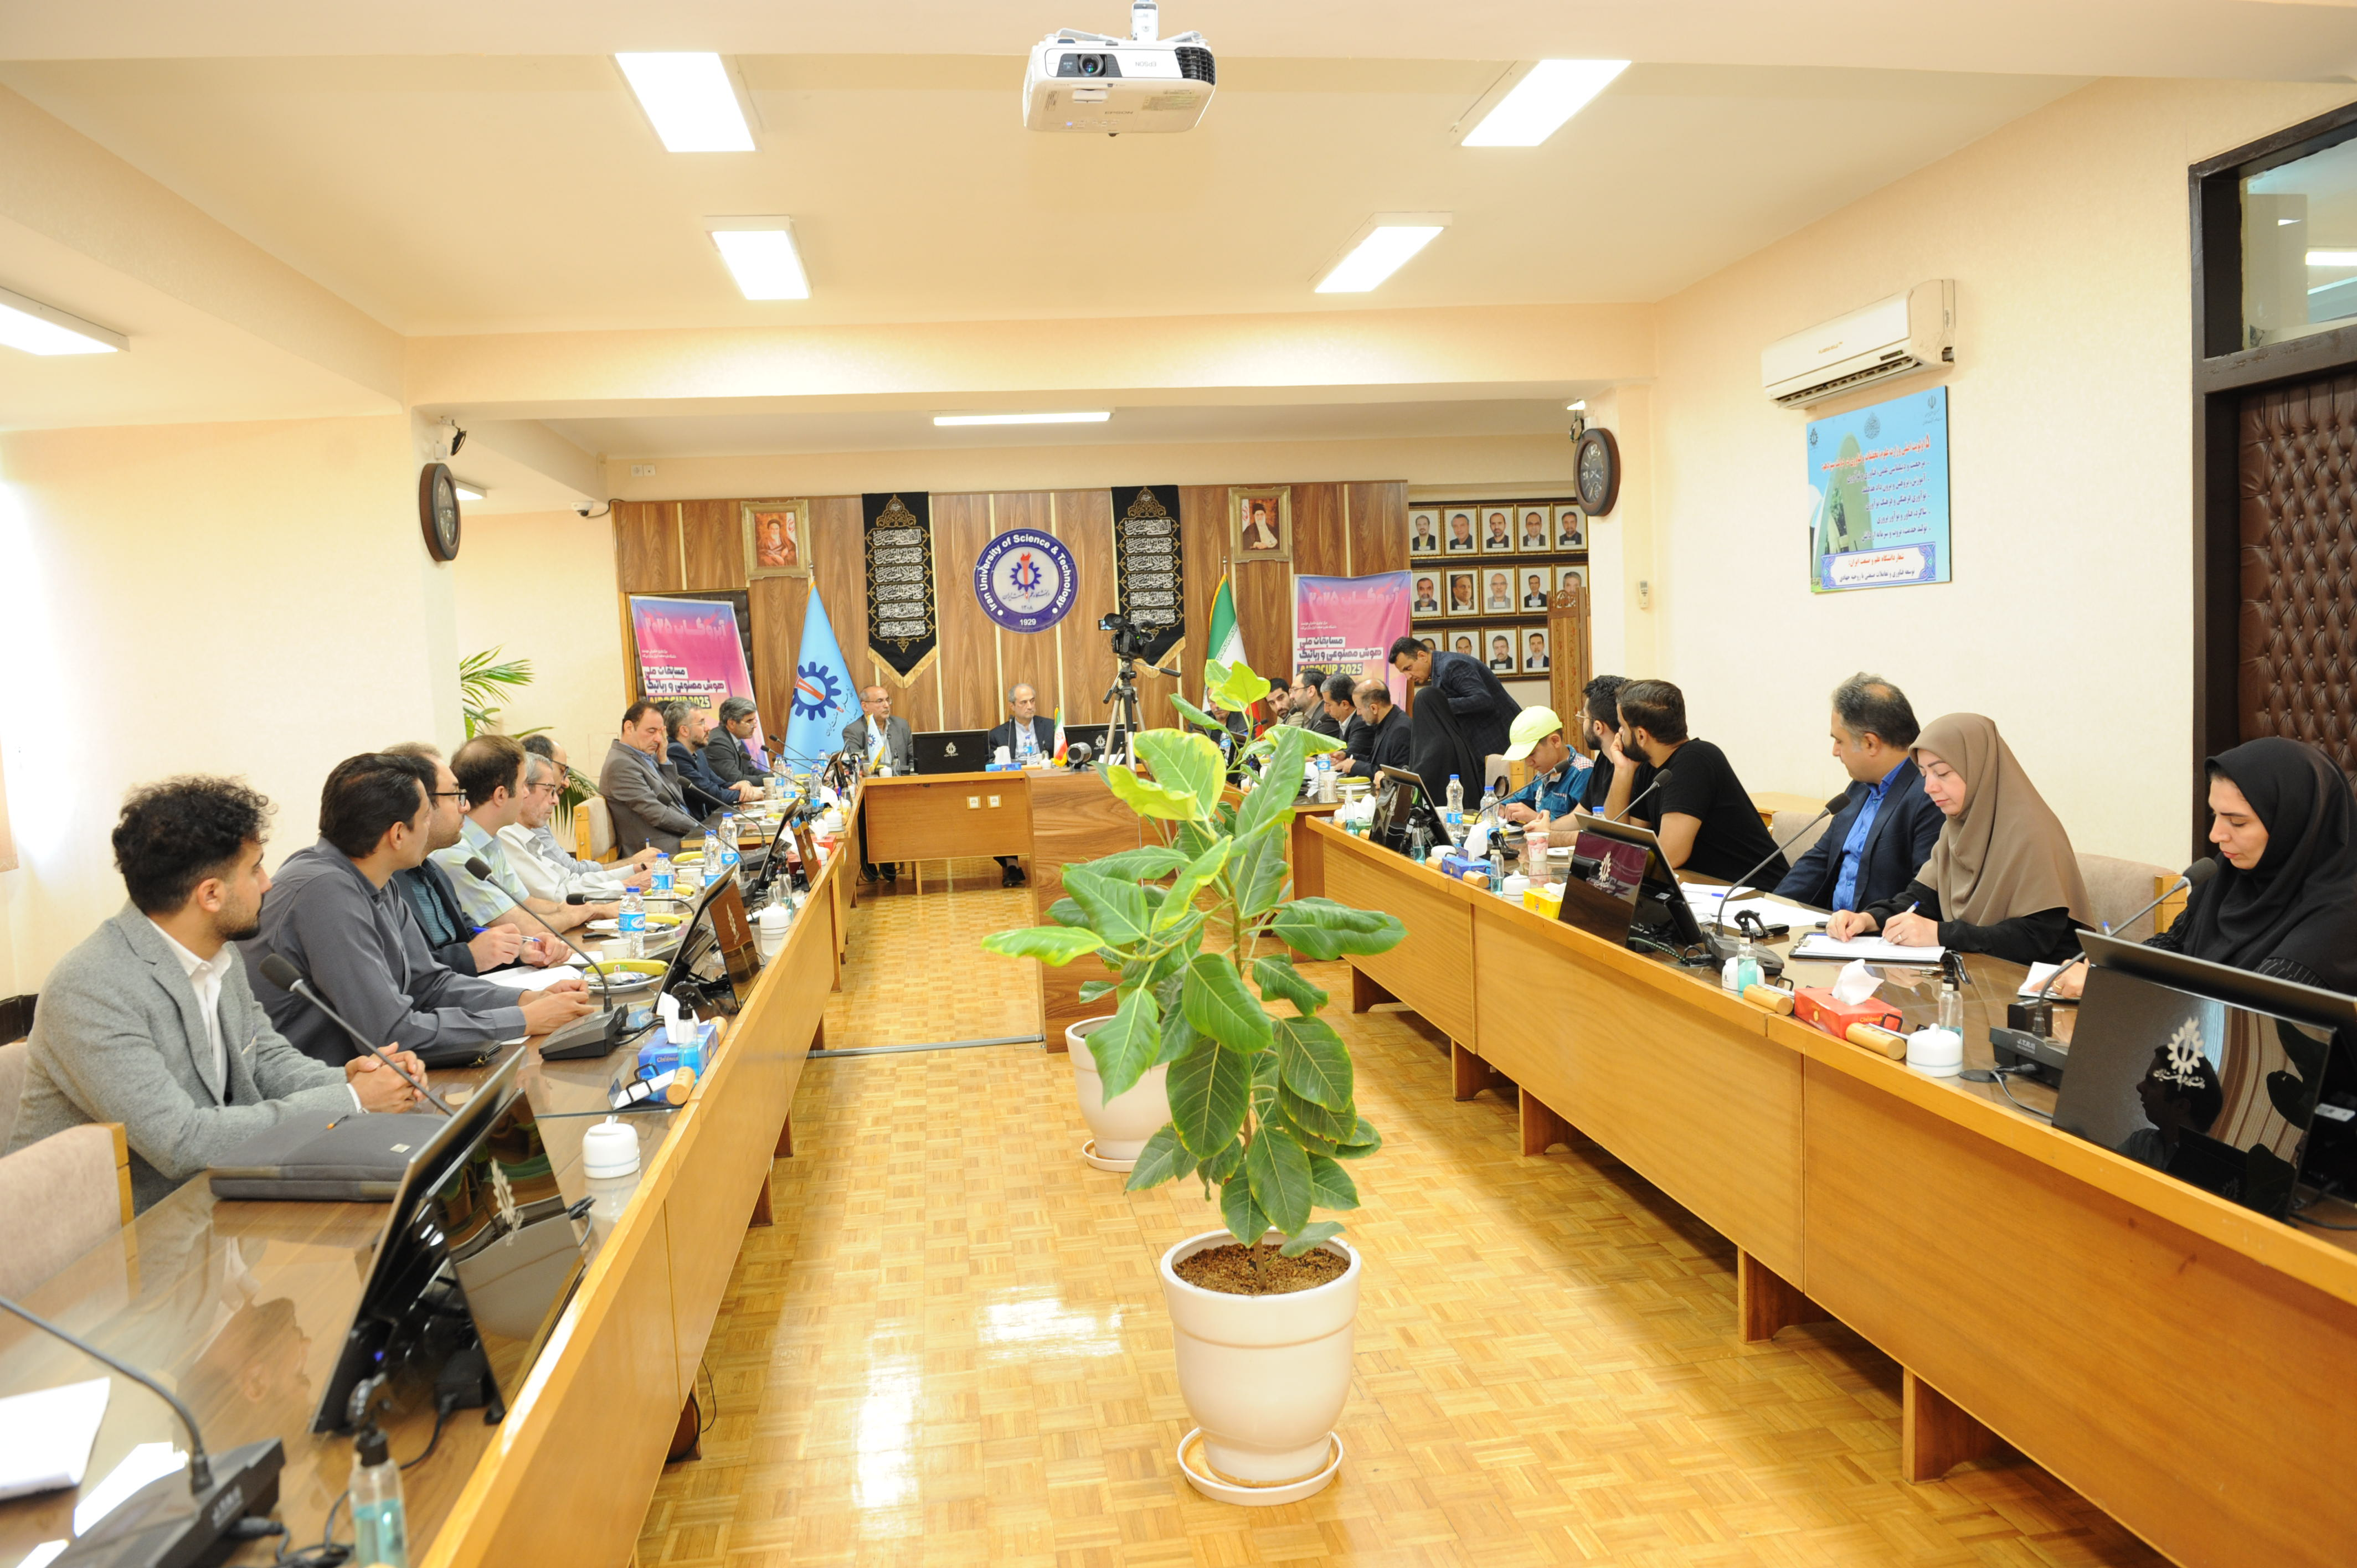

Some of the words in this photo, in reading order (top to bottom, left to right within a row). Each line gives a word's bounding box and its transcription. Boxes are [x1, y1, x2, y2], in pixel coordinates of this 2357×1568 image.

[1002, 537, 1012, 548] of
[1013, 534, 1050, 548] Science
[1050, 546, 1059, 555] &
[980, 545, 1002, 591] University
[1056, 553, 1072, 608] Technology
[984, 592, 997, 611] Iran
[1300, 637, 1312, 651] ملی
[1314, 636, 1344, 647] مسابقات
[1299, 649, 1320, 662] رباتیک
[1320, 652, 1326, 661] و
[1326, 648, 1358, 661] مصنوعی
[1360, 647, 1382, 659] هوش
[645, 666, 657, 679] ملی
[658, 665, 685, 678] مسابقات
[1340, 664, 1362, 674] 2025
[668, 683, 673, 692] و
[675, 680, 702, 693] مصنوعی
[703, 678, 724, 692] هوش
[688, 696, 710, 708] 2025
